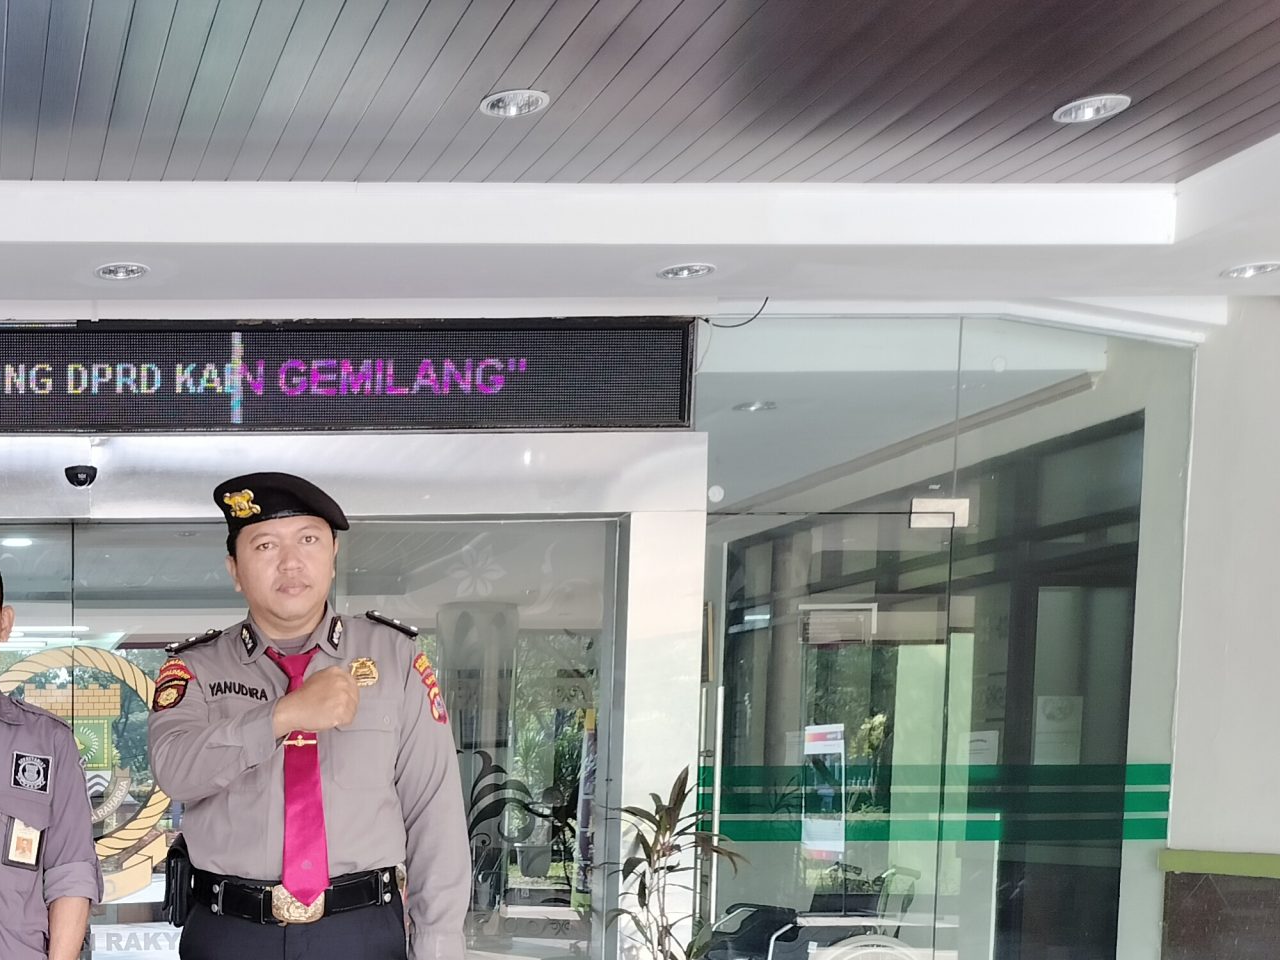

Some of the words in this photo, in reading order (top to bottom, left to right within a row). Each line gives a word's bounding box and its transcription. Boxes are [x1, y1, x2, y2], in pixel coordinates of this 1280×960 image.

[68, 363, 161, 394] DPRD
[279, 358, 527, 396] GEMILANG"
[96, 780, 129, 818] RAHARJA
[106, 932, 181, 952] RAKY
